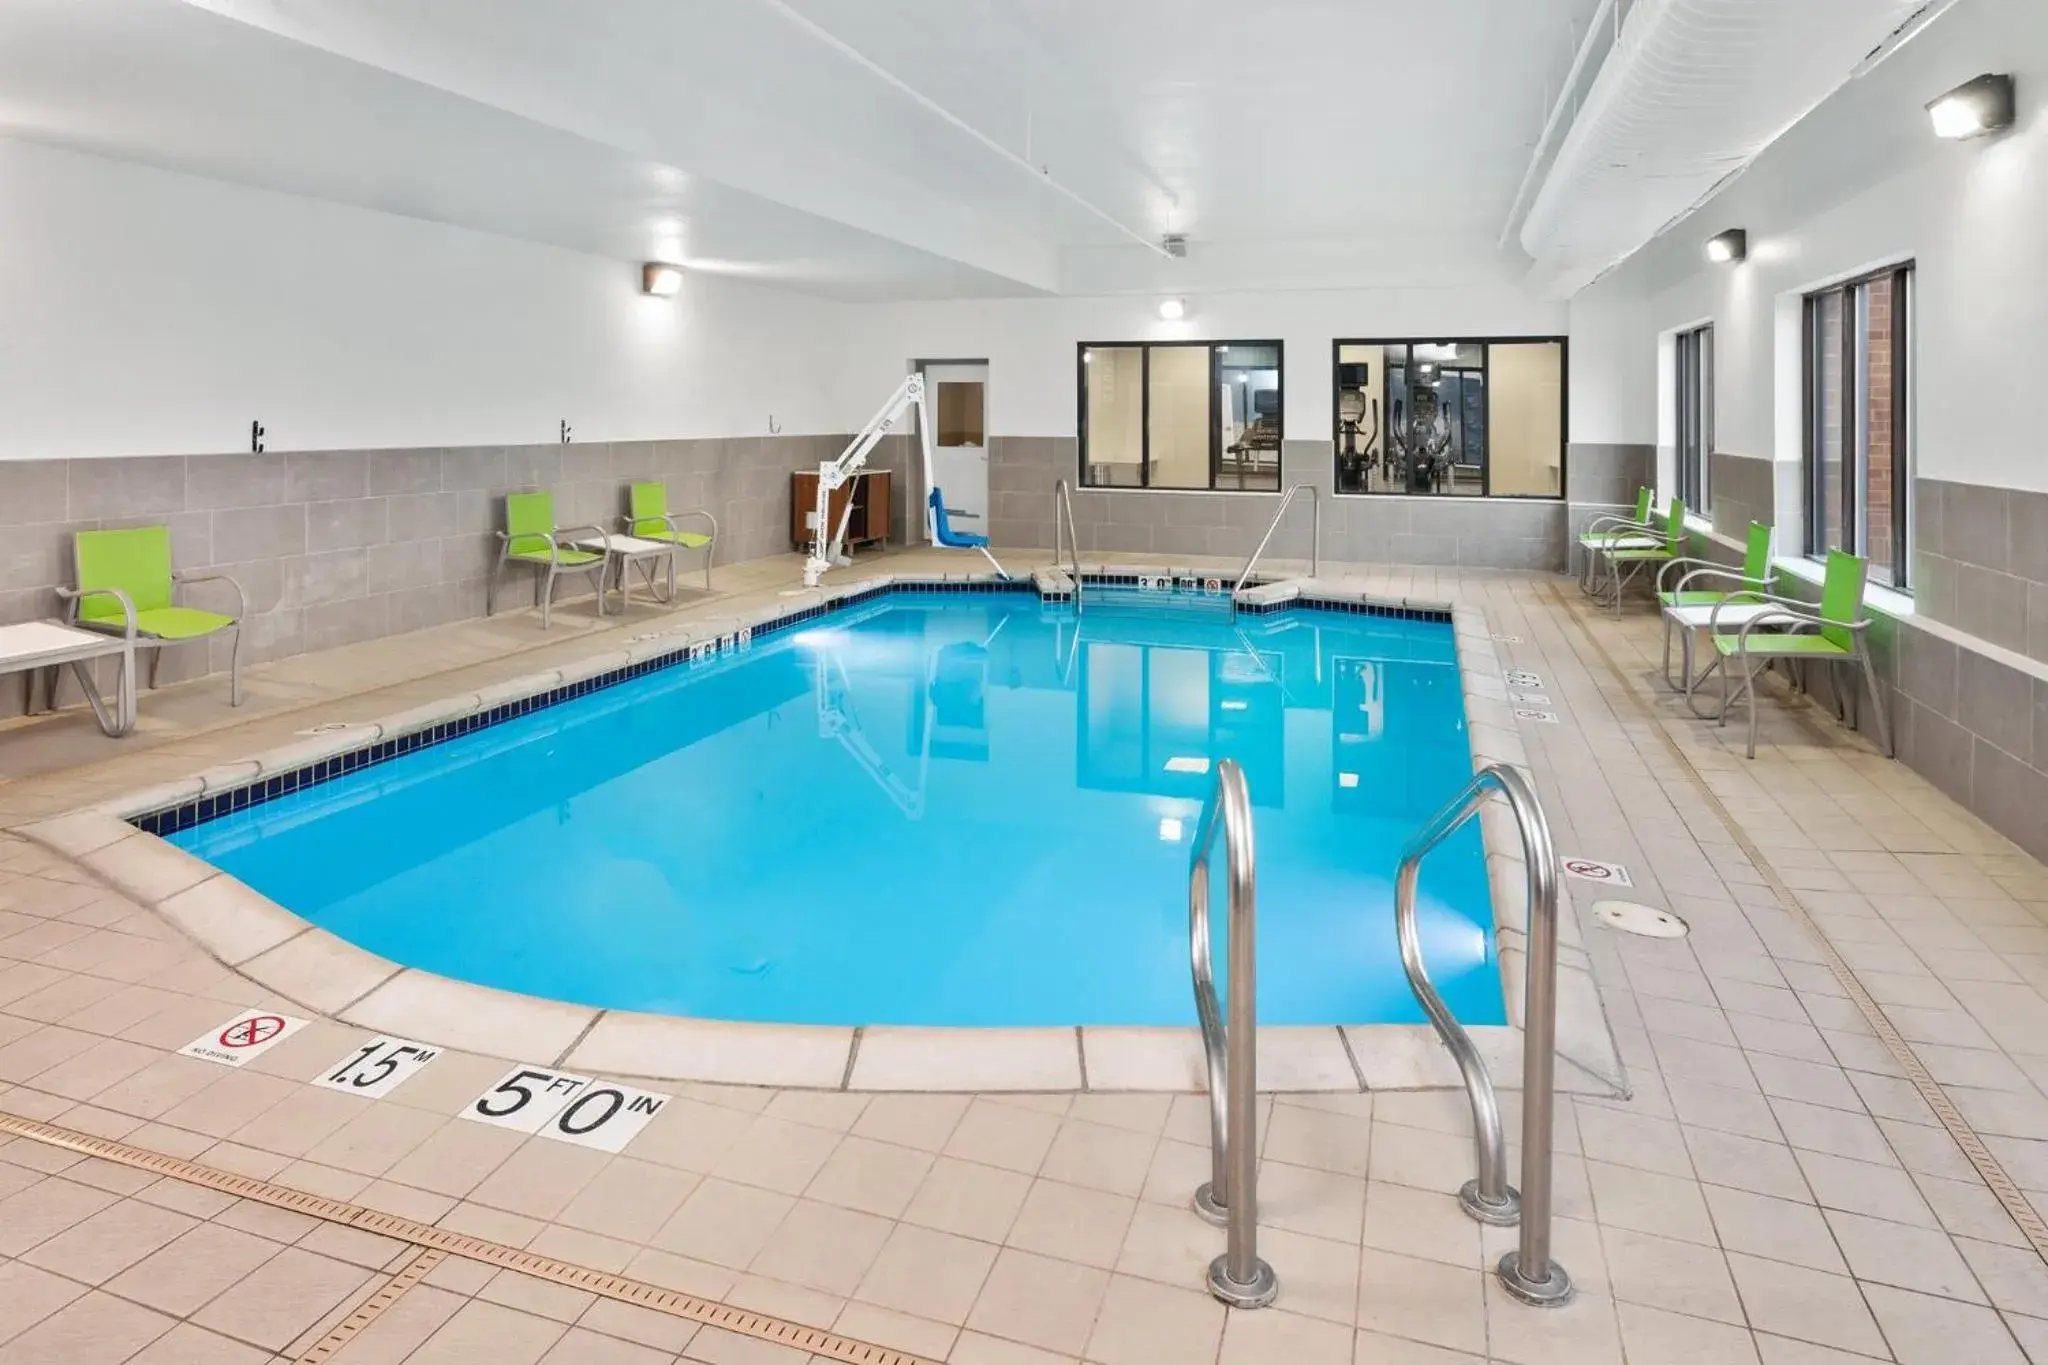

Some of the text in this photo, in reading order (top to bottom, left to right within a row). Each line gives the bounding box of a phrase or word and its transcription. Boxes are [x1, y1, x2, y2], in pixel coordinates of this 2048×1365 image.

[206, 1051, 238, 1061] DIVING
[328, 1042, 436, 1087] 1.5 M
[476, 1070, 664, 1135] 5 FT 0 IN
